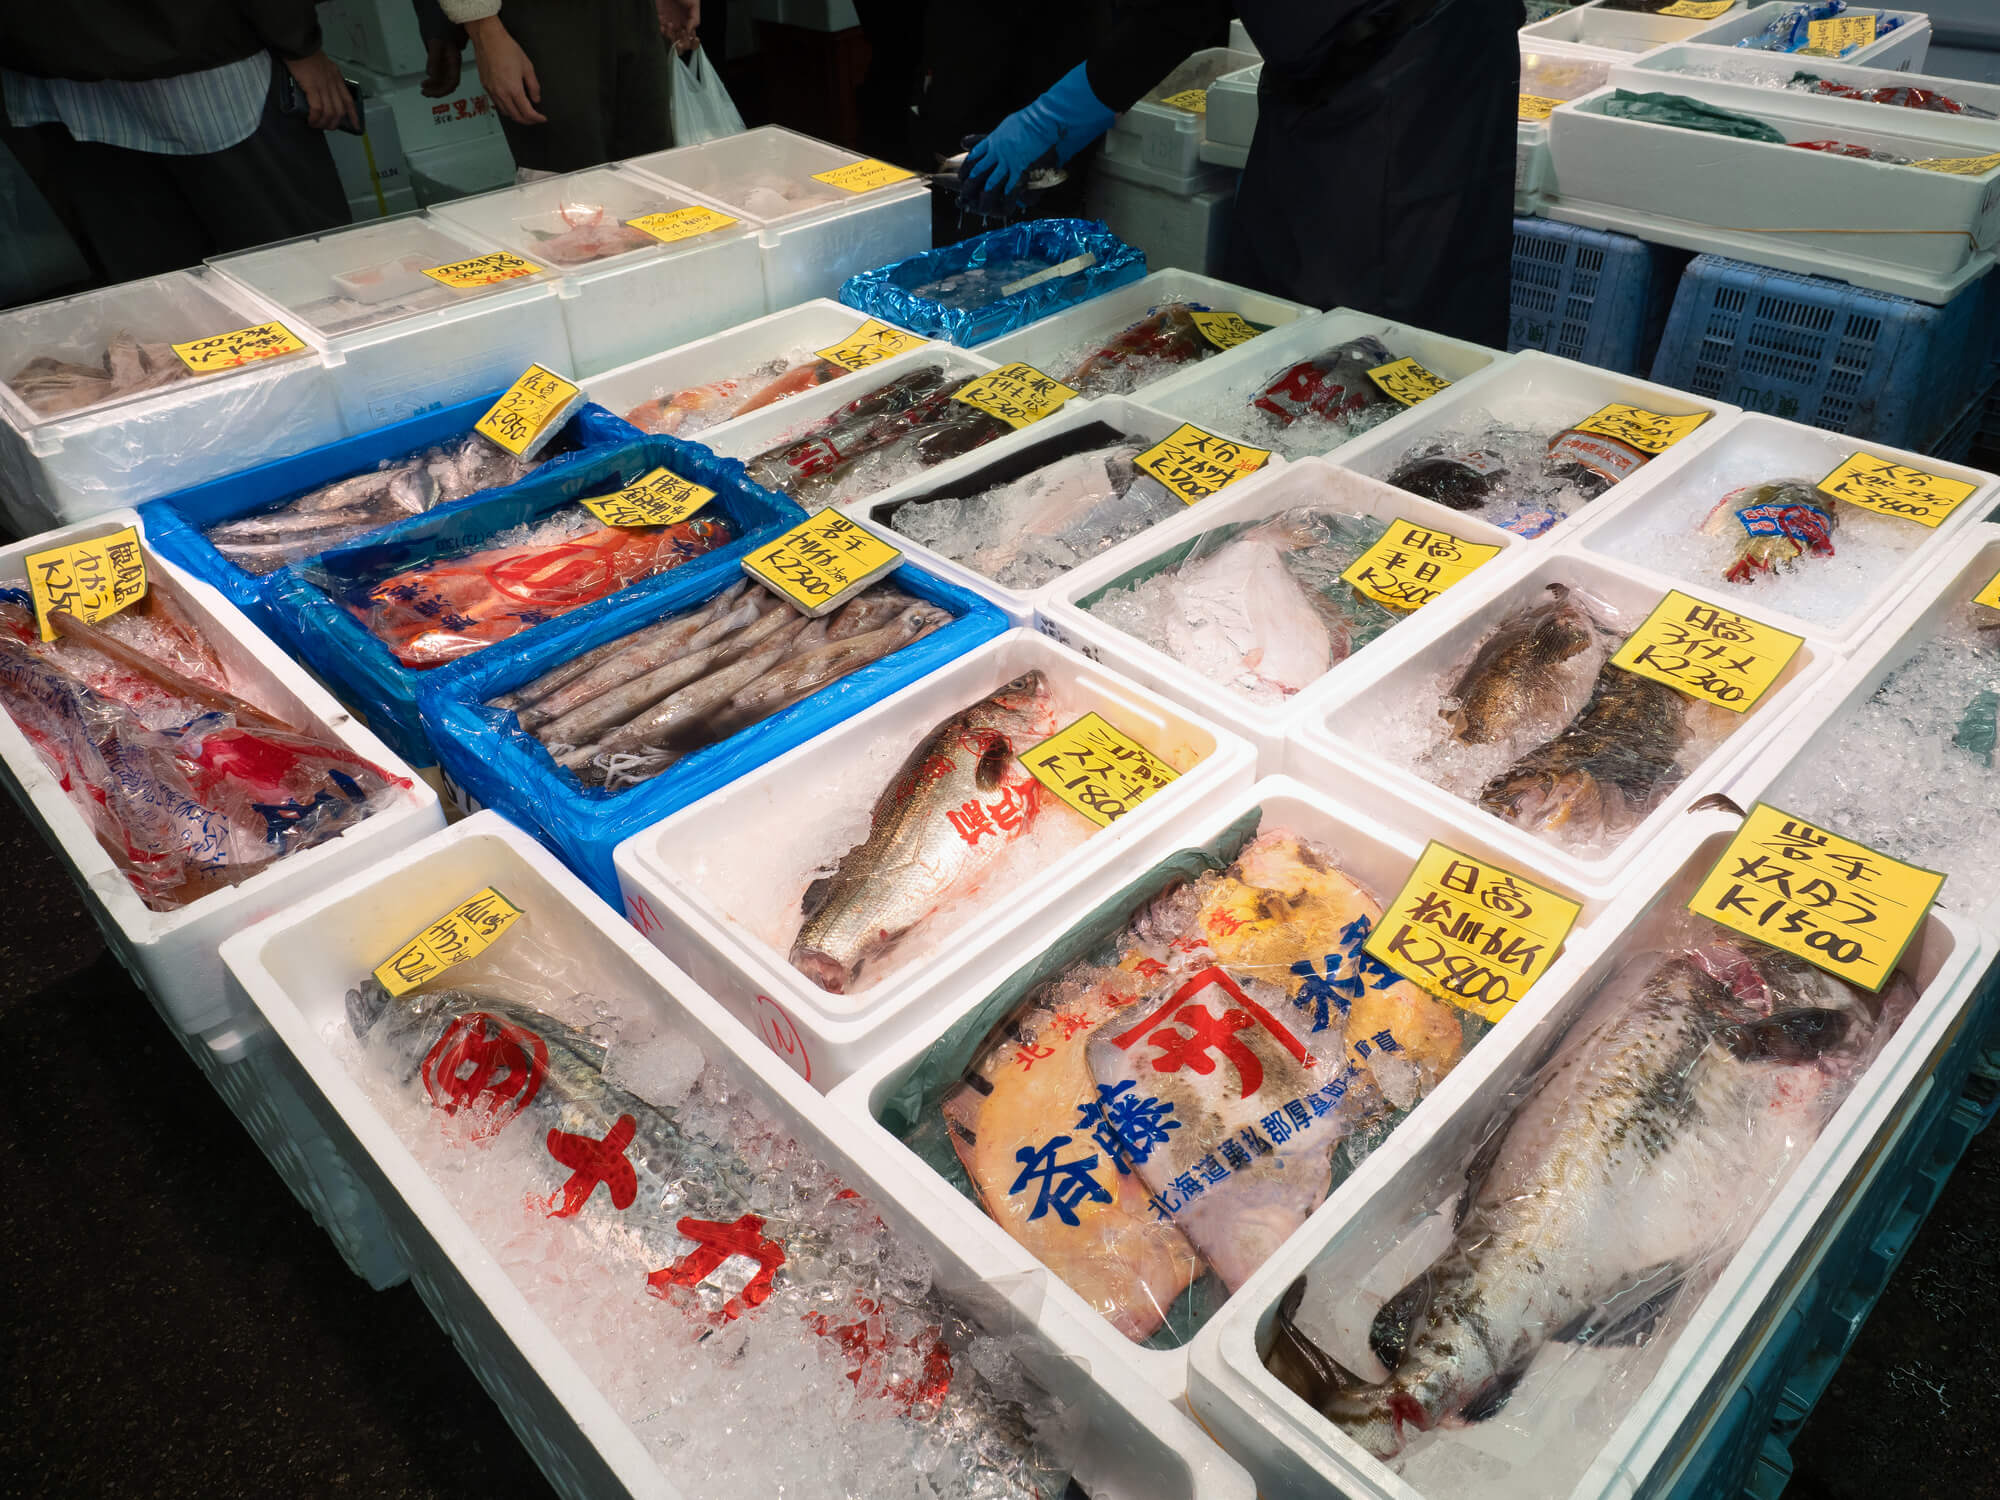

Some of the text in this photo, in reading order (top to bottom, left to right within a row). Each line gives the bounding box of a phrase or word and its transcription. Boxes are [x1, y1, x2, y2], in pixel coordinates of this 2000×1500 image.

[998, 366, 1057, 397] 島根
[1184, 434, 1241, 463] 大分
[815, 519, 875, 551] 岩手
[1402, 529, 1464, 562] 日高
[1685, 605, 1755, 643] 日高
[1063, 739, 1145, 803] スズキ
[1761, 821, 1883, 882] 岩手
[1440, 860, 1534, 919] 日高
